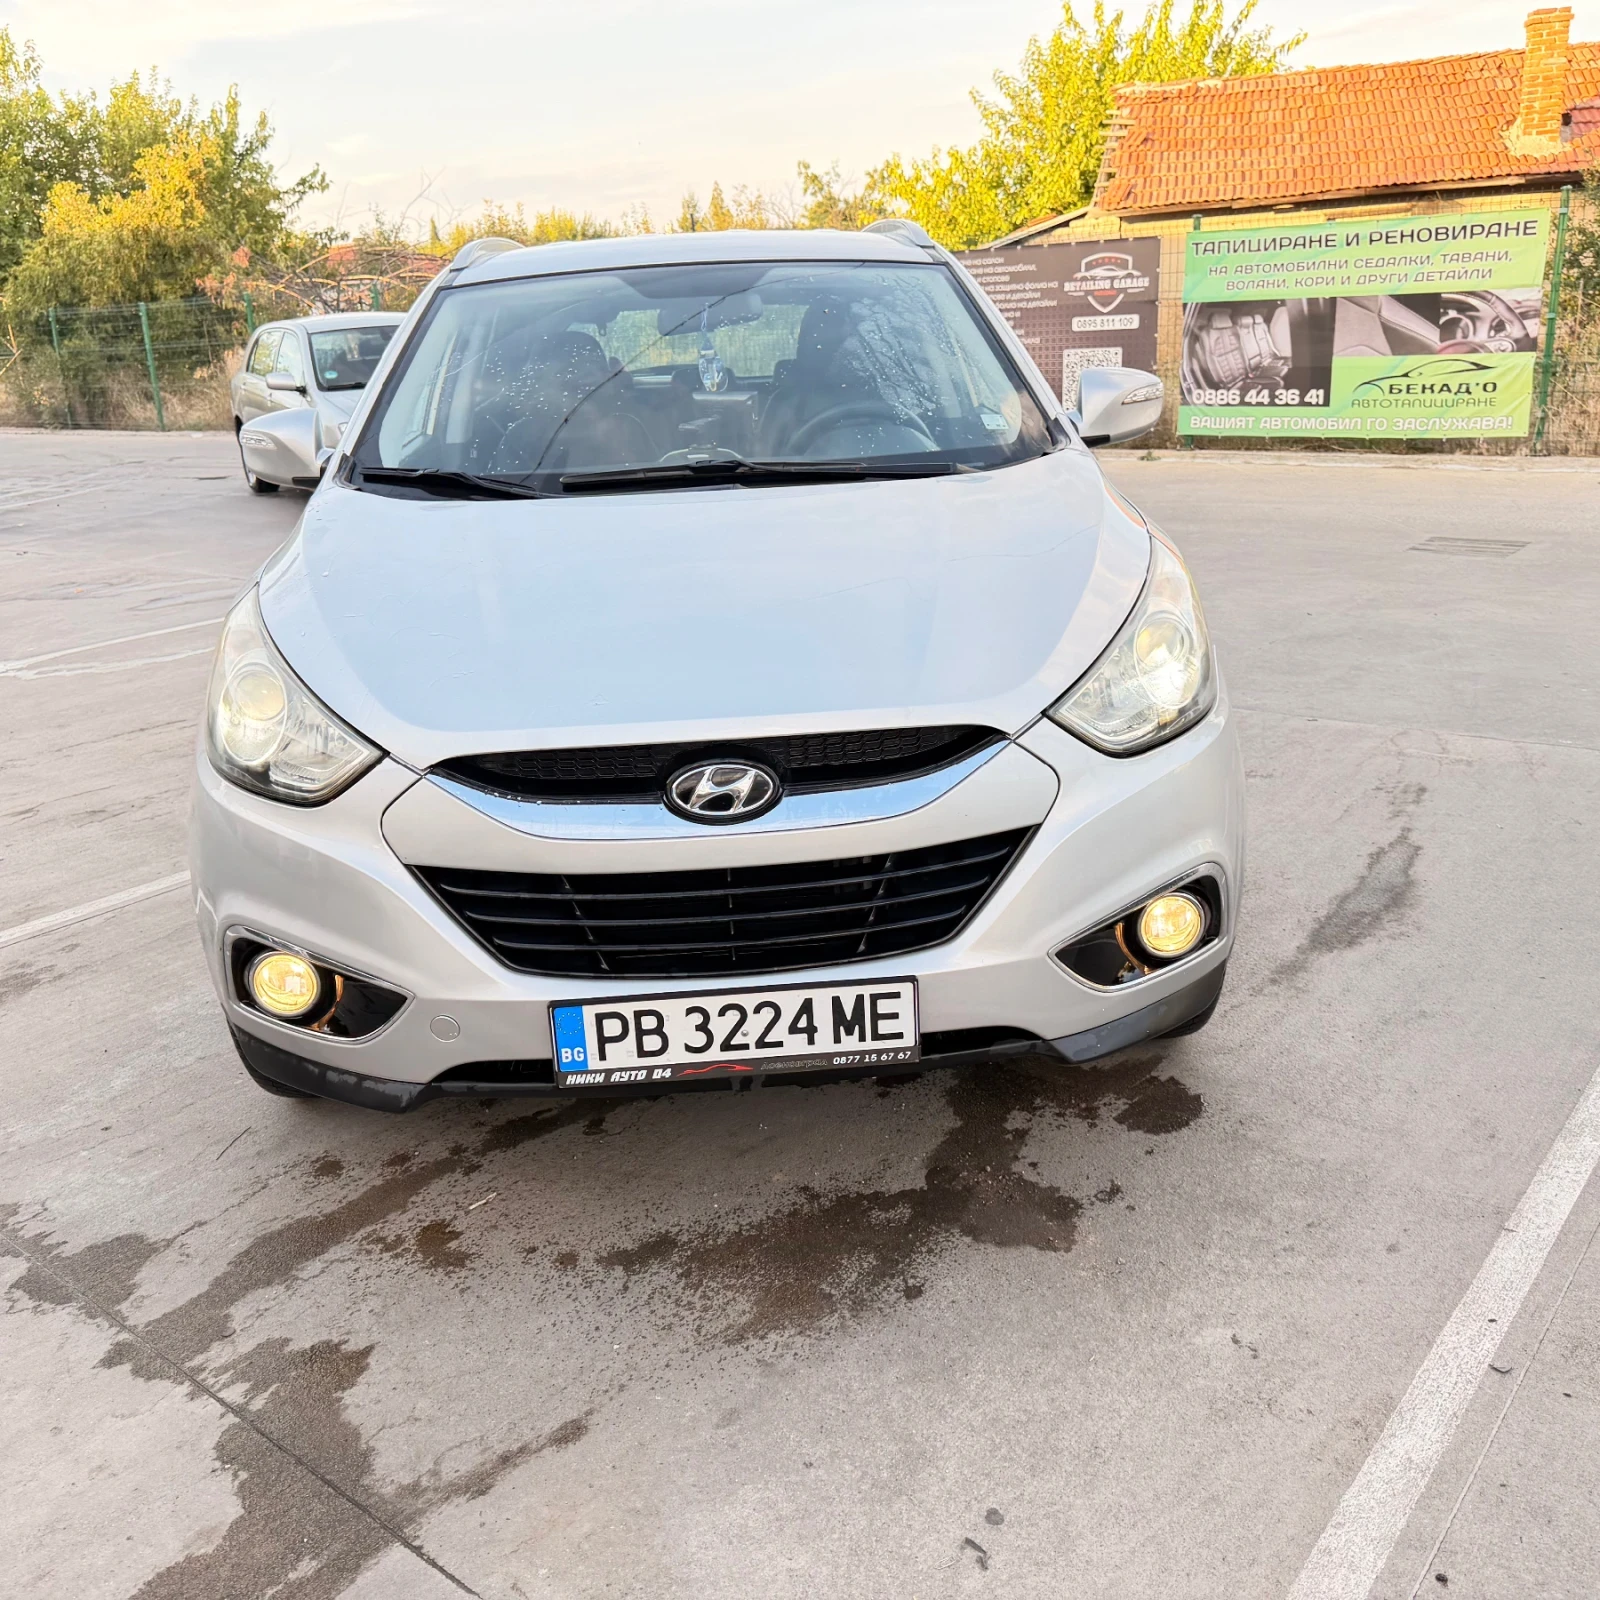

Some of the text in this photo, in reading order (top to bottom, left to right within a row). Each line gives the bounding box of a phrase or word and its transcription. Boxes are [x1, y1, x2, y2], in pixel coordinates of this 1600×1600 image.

[1192, 220, 1538, 256] ТАПИЦИРАНЕ И РЕНОВИРАНЕ
[1208, 251, 1513, 276] НА АВТОМОБИЛНИ СЕДАЛКИ, ТАВАНИ,
[1063, 277, 1149, 292] DETAILING GARAGE
[1226, 267, 1492, 291] ВОЛАНИ, КОРИ И ДРУГИ ДЕТАЙЛИ
[1192, 388, 1325, 405] 0886 44 36 41
[1190, 416, 1513, 431] ВАШИЯТ АВТОМОБИЛ ГО ЗАСЛУЖАВА!
[595, 991, 904, 1061] PB 3224 ME
[561, 1047, 585, 1063] BG
[833, 1051, 912, 1065] 0877 15 67 67
[566, 1072, 605, 1085] НИКИ
